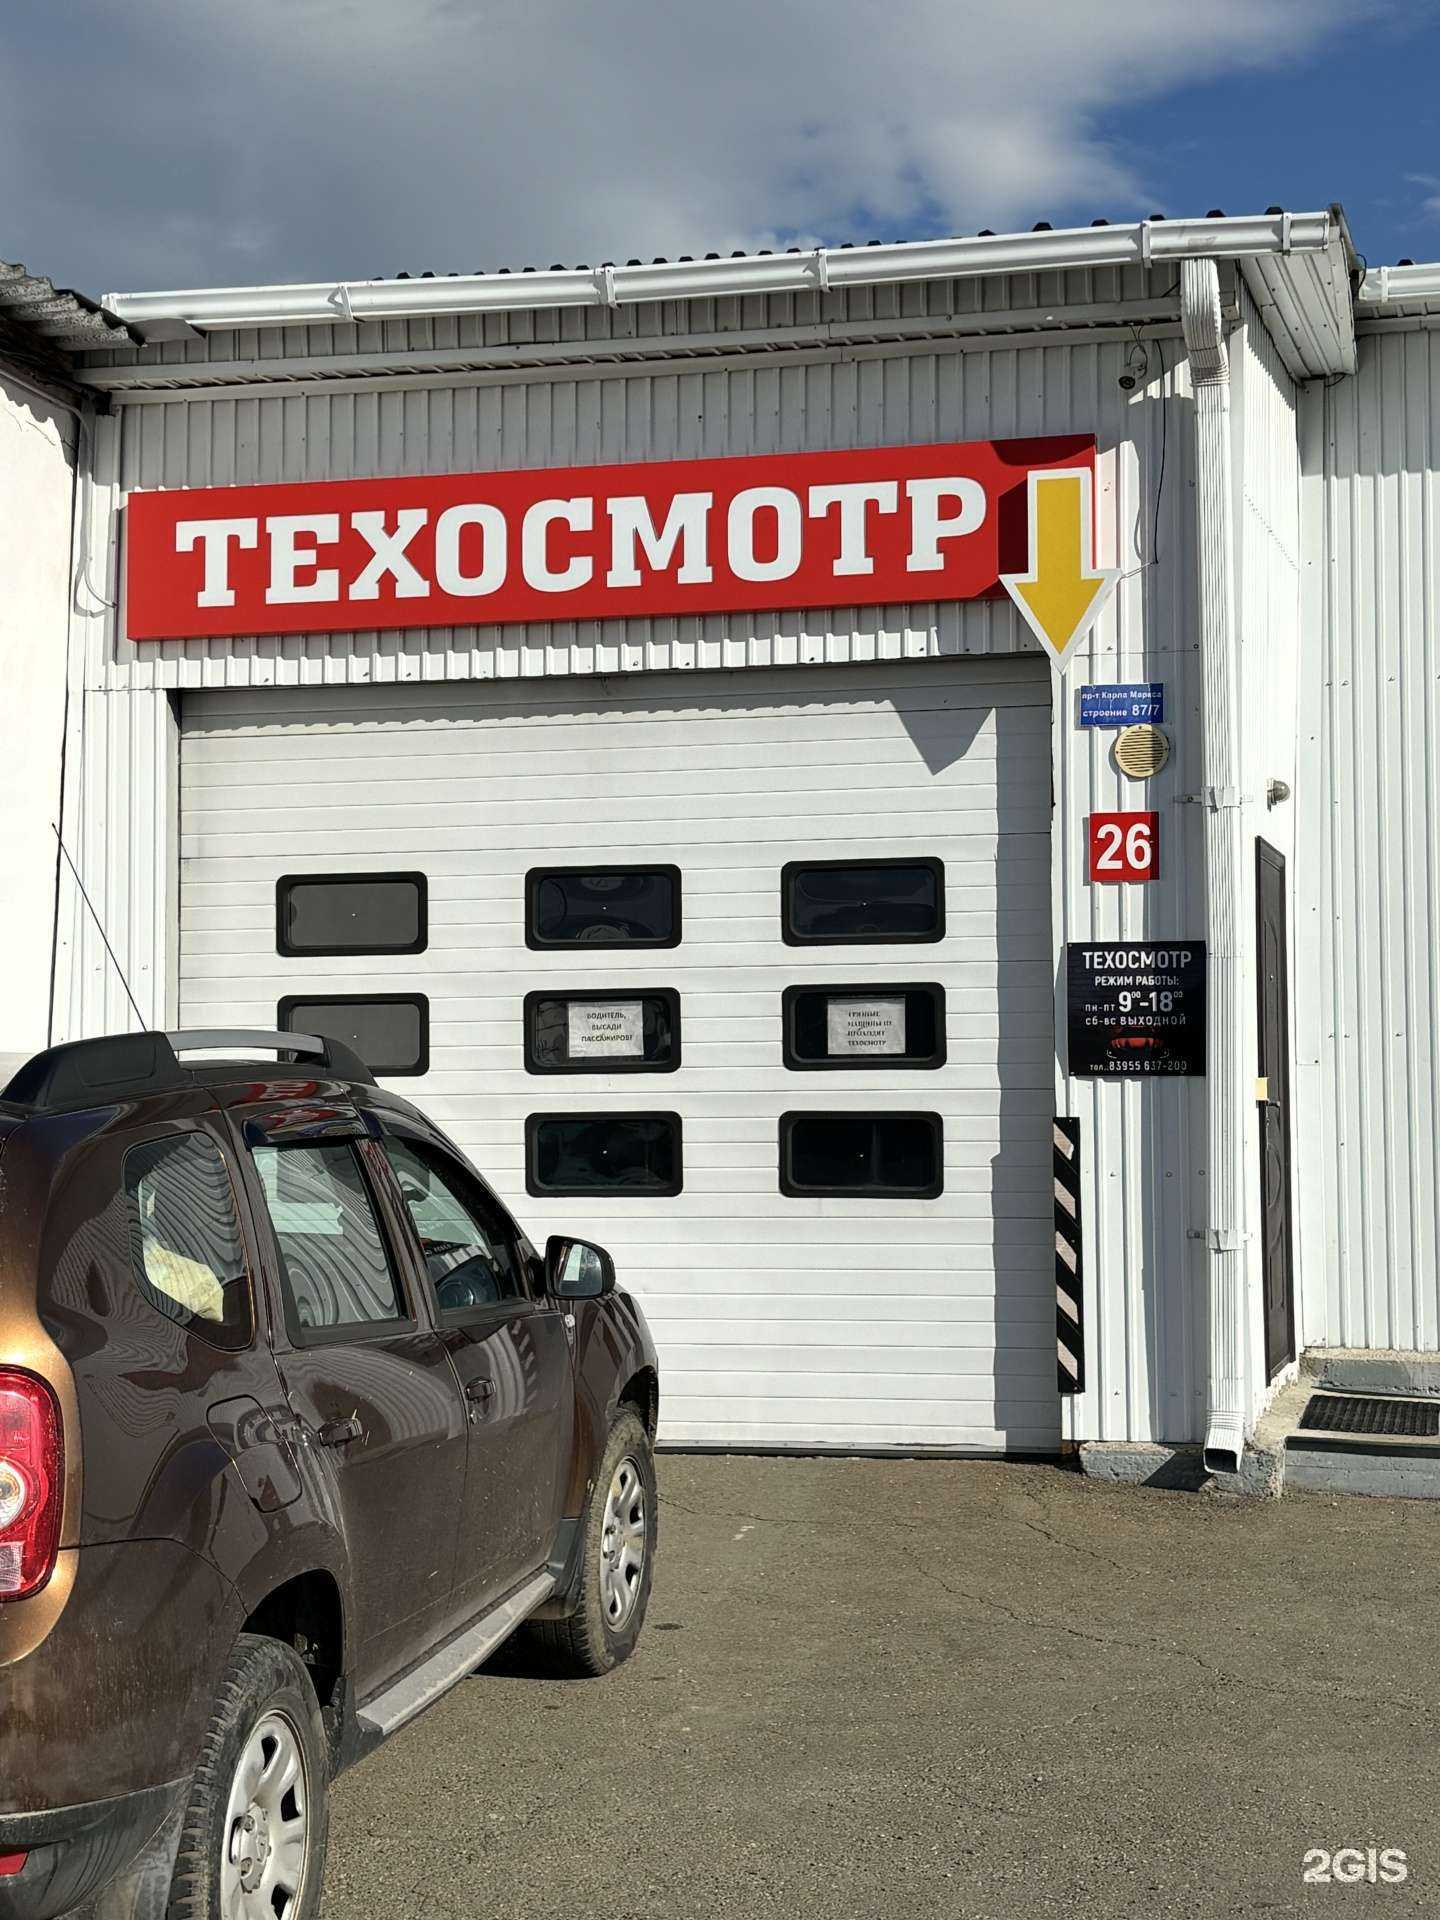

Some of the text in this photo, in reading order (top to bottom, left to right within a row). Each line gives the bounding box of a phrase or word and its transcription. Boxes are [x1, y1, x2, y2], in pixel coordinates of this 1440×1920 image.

[175, 476, 988, 609] ТЕХОСМОТР
[1101, 691, 1128, 699] Карла
[1129, 690, 1162, 698] Маркса
[1082, 704, 1160, 718] строение 87/7
[1096, 822, 1152, 870] 26
[1082, 951, 1192, 969] ТЕХОСМОТР
[1095, 975, 1180, 986] РЕЖИМ РАБОТЫ:
[1085, 1004, 1116, 1012] пн-пт
[1085, 1017, 1116, 1026] сб-вс
